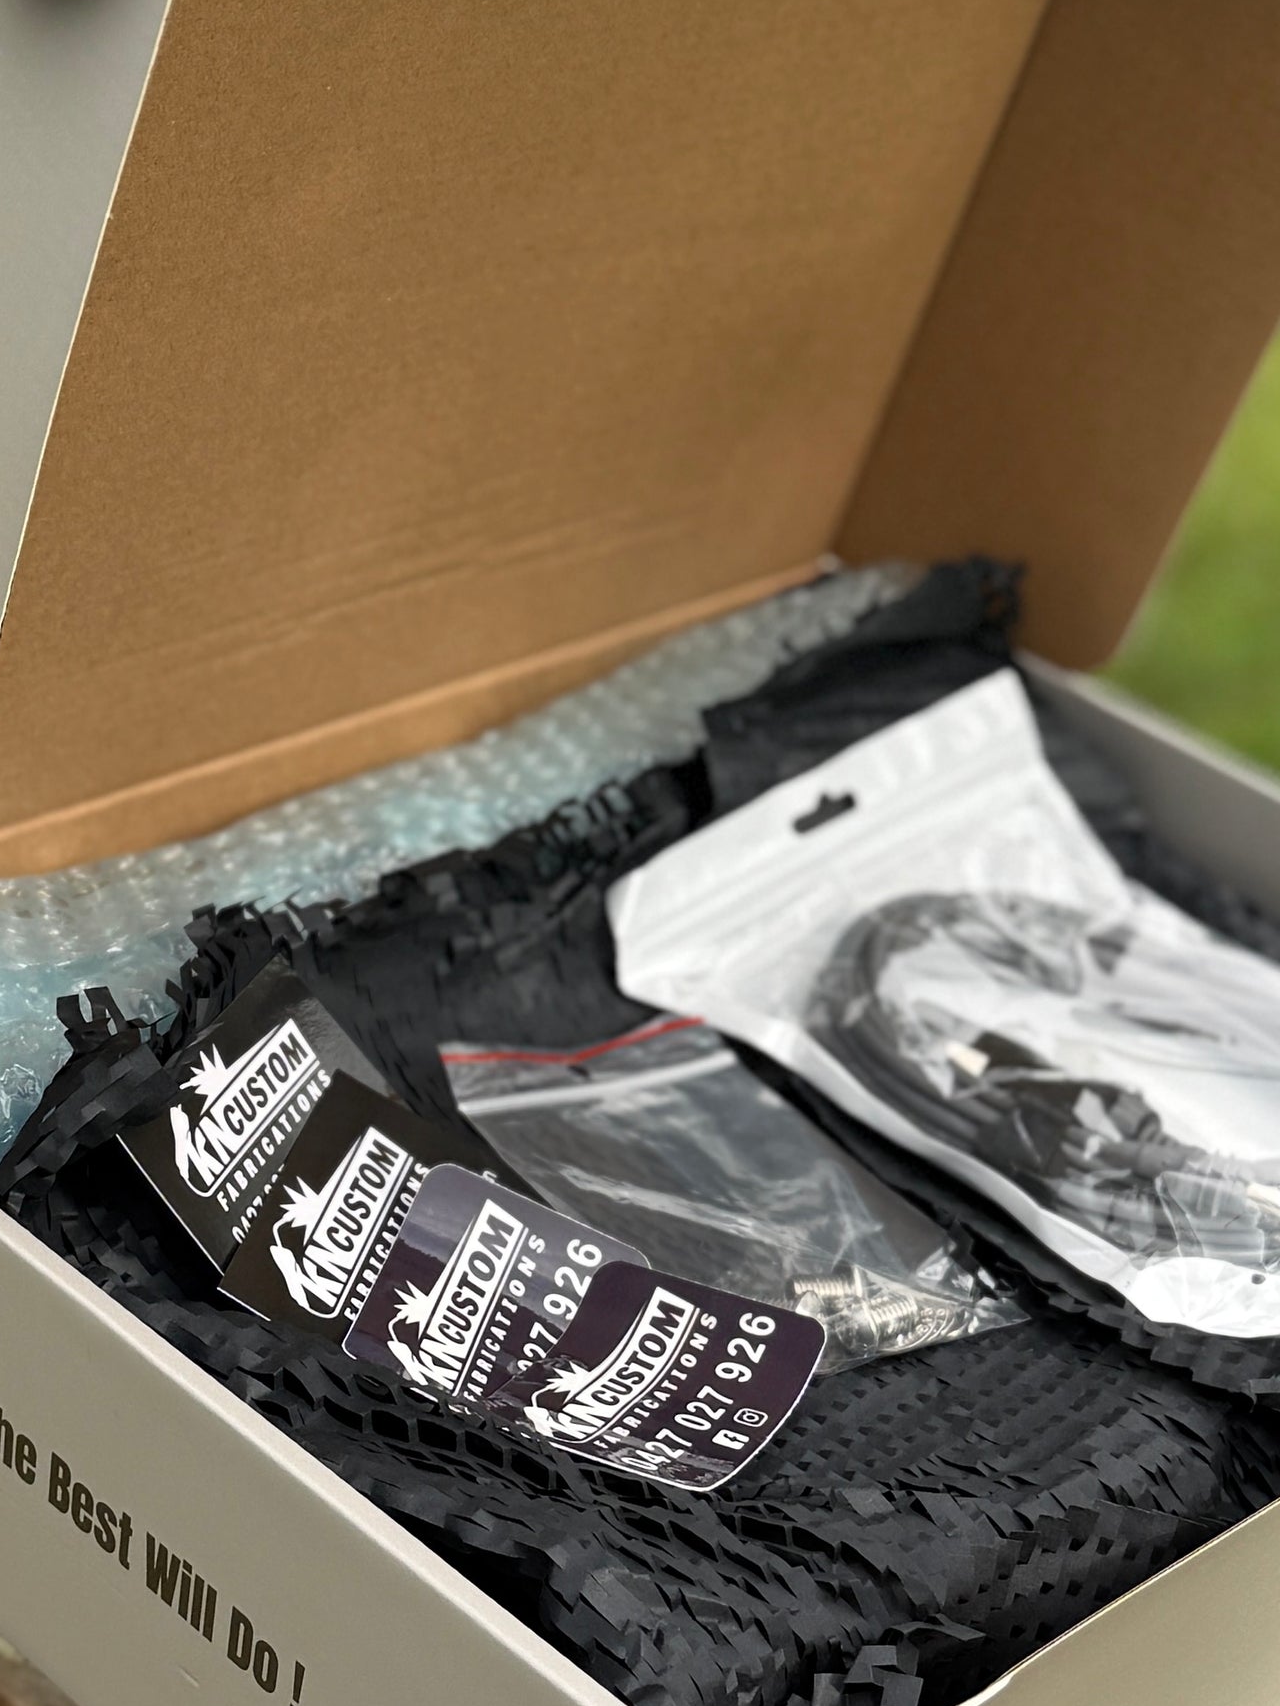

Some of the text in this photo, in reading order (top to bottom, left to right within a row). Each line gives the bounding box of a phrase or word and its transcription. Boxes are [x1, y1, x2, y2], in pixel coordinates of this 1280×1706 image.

[216, 1069, 332, 1212] FABRICATIONS
[223, 1032, 309, 1136] CUSTOM
[326, 1139, 400, 1252] CUSTOM
[438, 1214, 515, 1345] CUSTOM
[463, 1234, 546, 1402] FABRICATIONS
[543, 1239, 603, 1320] 926
[590, 1299, 686, 1408] CUSTOM
[593, 1312, 718, 1449] FABRICATIONS
[621, 1312, 776, 1471] 0427 027 926
[48, 1451, 133, 1570] Best
[145, 1531, 218, 1643] Will
